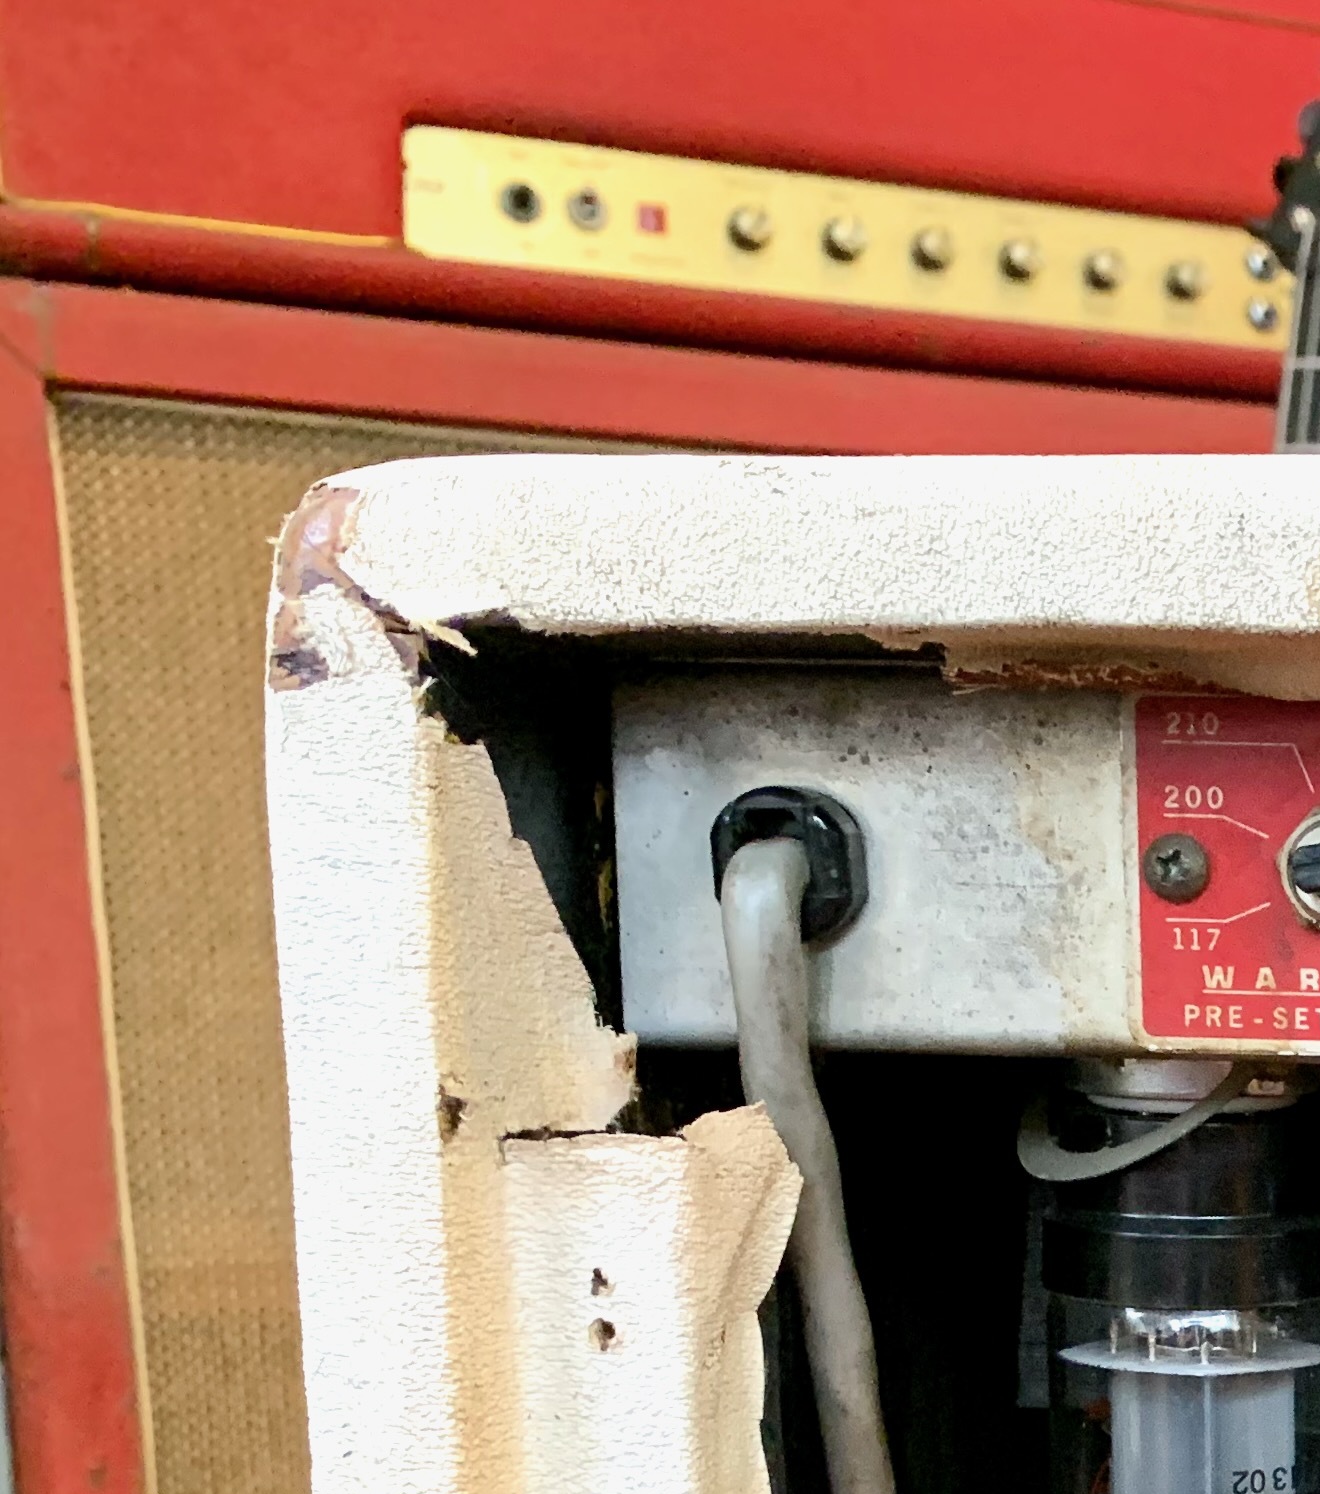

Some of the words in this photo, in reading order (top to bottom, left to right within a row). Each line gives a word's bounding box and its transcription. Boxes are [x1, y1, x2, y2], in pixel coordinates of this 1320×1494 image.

[1166, 712, 1220, 735] 210
[1164, 785, 1224, 809] 200
[1172, 928, 1221, 951] 117
